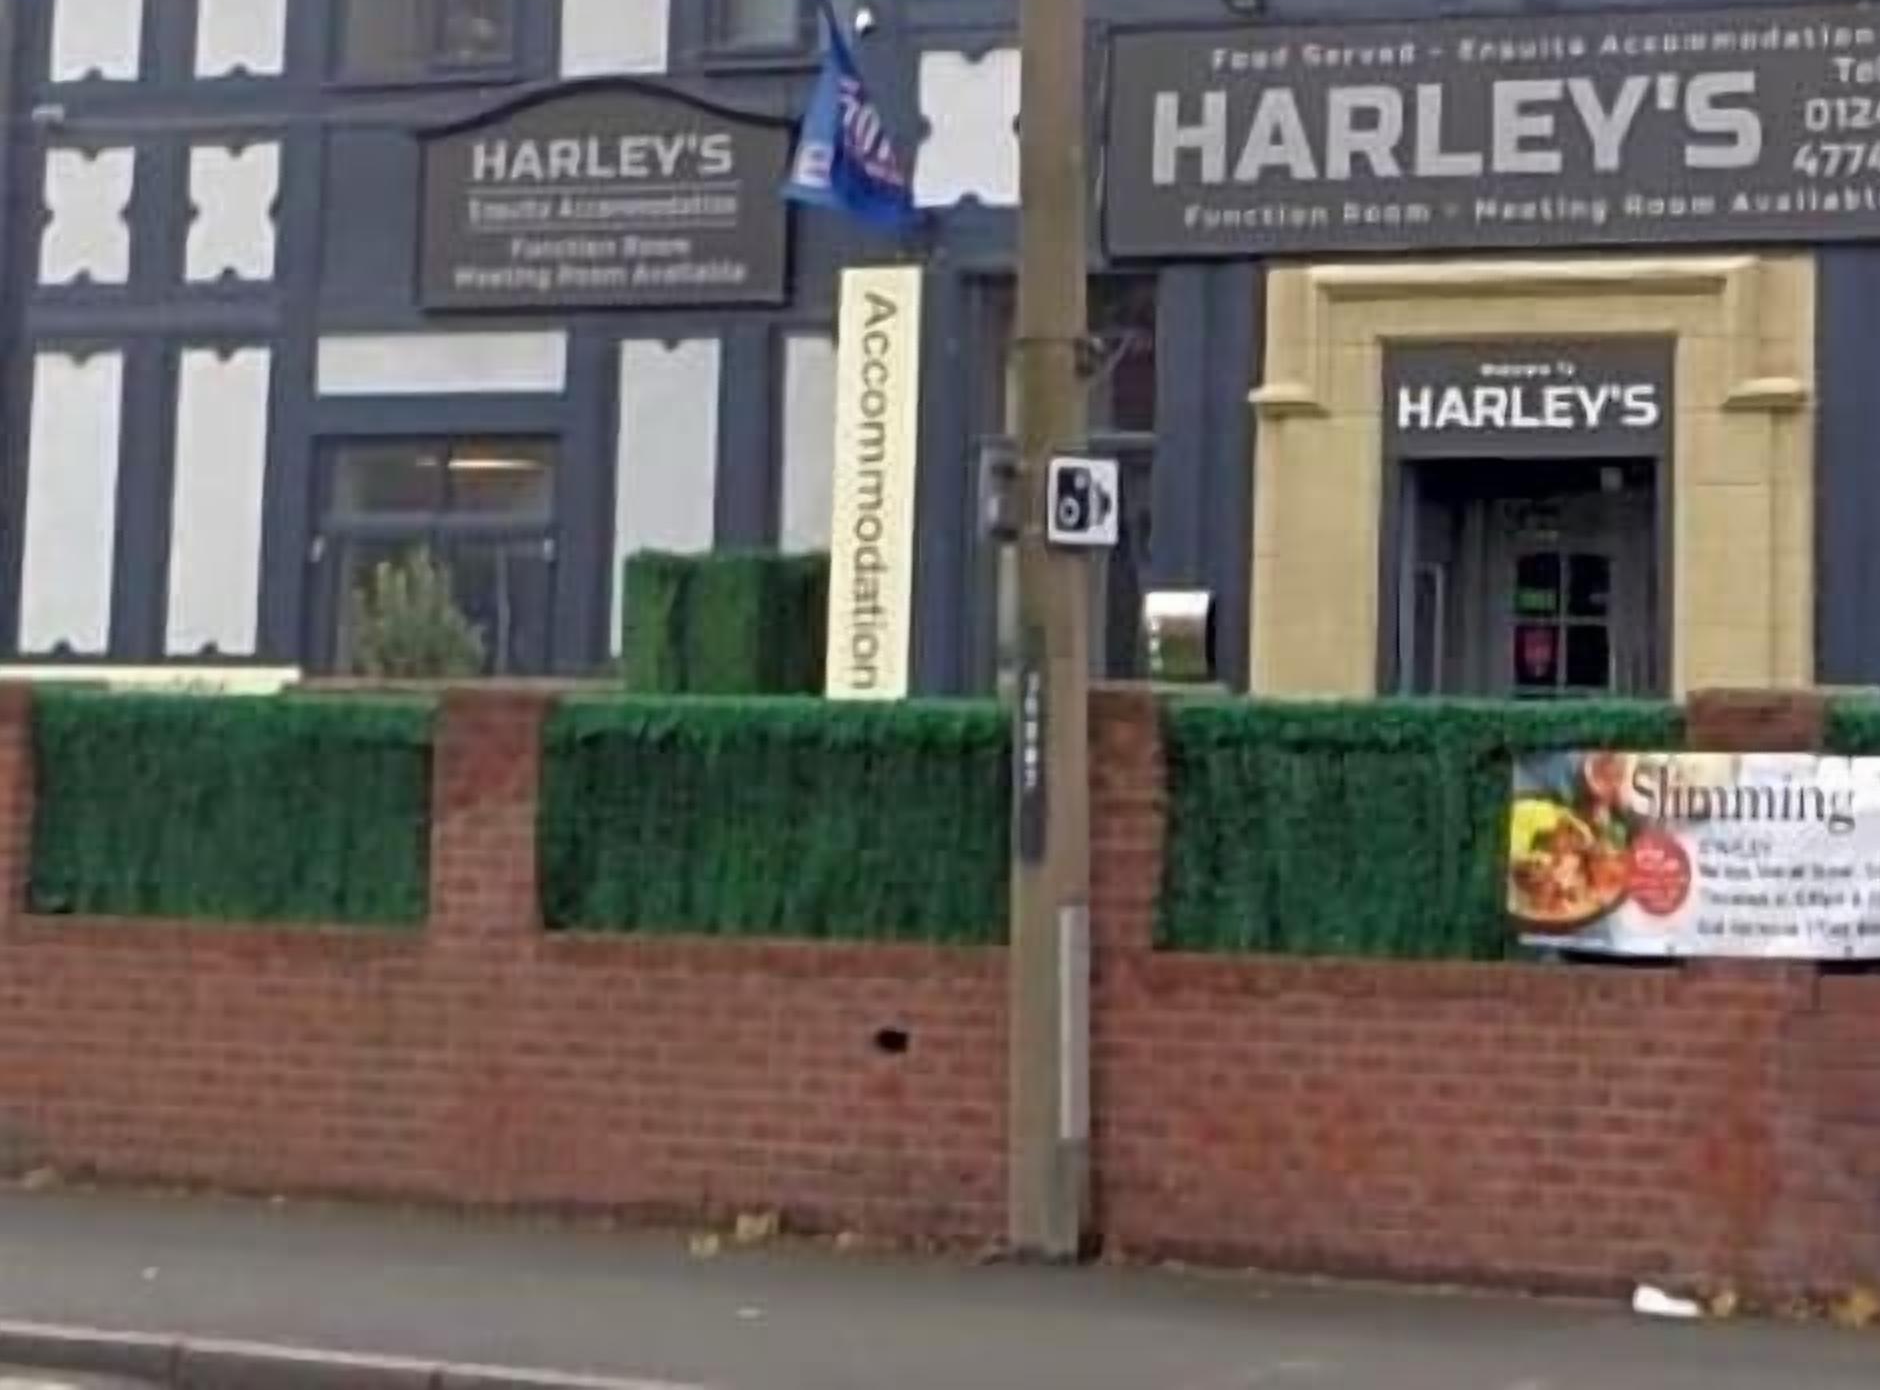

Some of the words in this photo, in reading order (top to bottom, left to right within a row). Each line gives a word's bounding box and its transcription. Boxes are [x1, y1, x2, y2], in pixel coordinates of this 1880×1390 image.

[473, 133, 733, 181] HARLEY'S
[1153, 70, 1763, 185] HARLEY'S
[1398, 384, 1660, 428] HARLEY'S
[851, 290, 898, 691] Accommodation
[1631, 763, 1856, 832] Slimming
